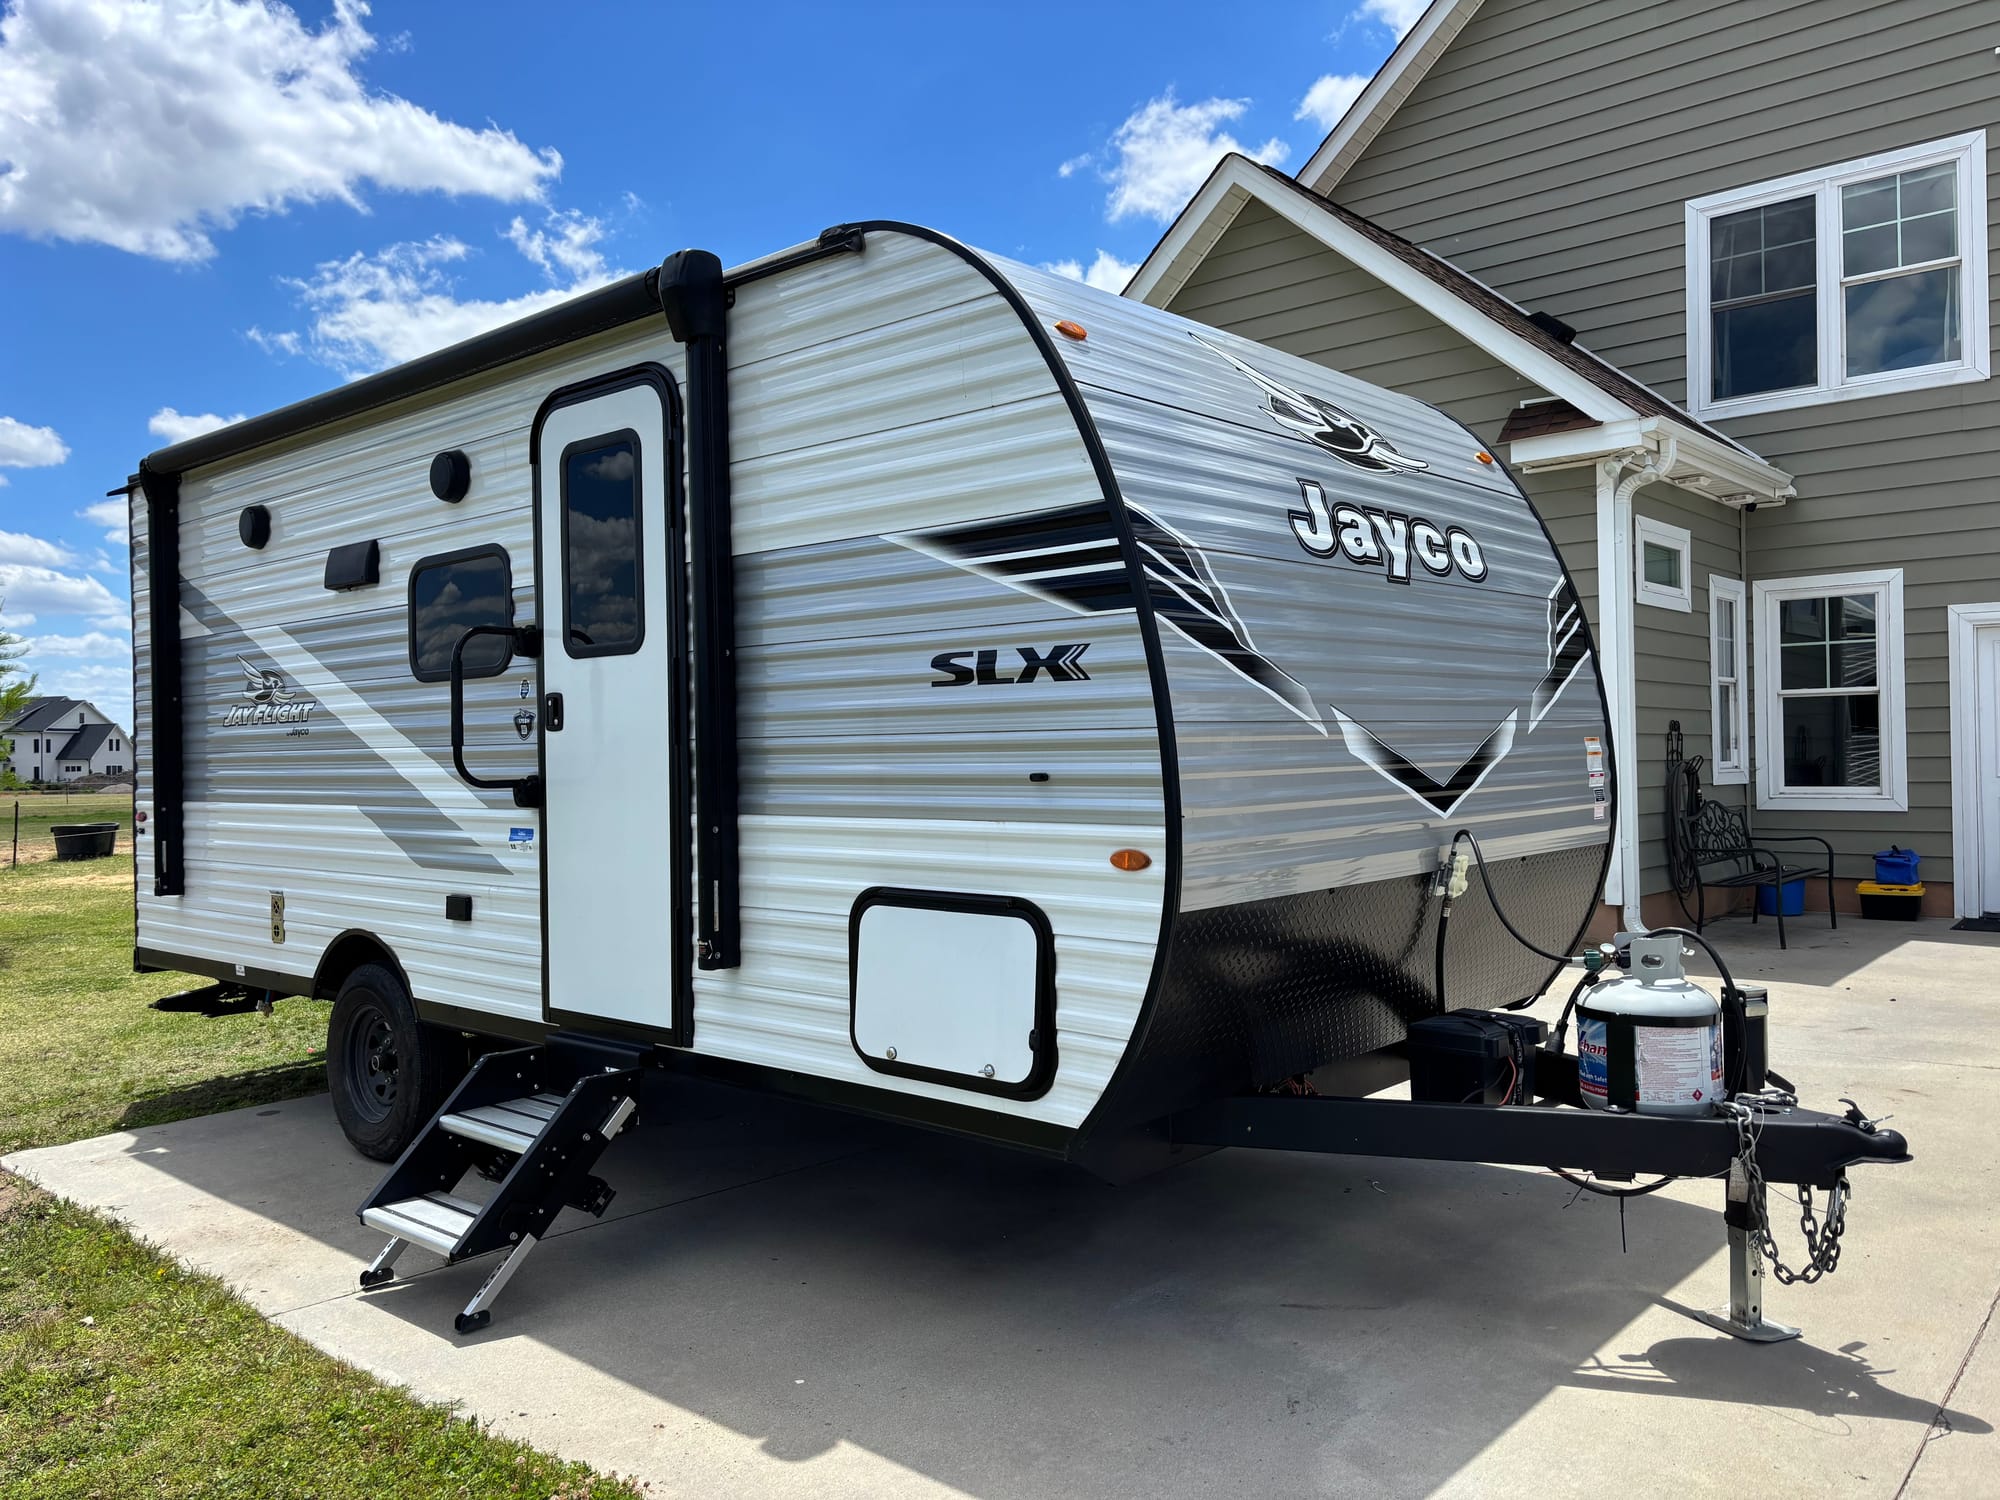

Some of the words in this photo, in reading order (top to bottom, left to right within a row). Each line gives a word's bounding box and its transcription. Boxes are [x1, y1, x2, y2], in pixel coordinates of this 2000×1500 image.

[1288, 477, 1488, 585] Jayco
[931, 643, 1091, 687] SLX
[223, 704, 254, 727] JAY
[252, 701, 316, 725] FLIGHT
